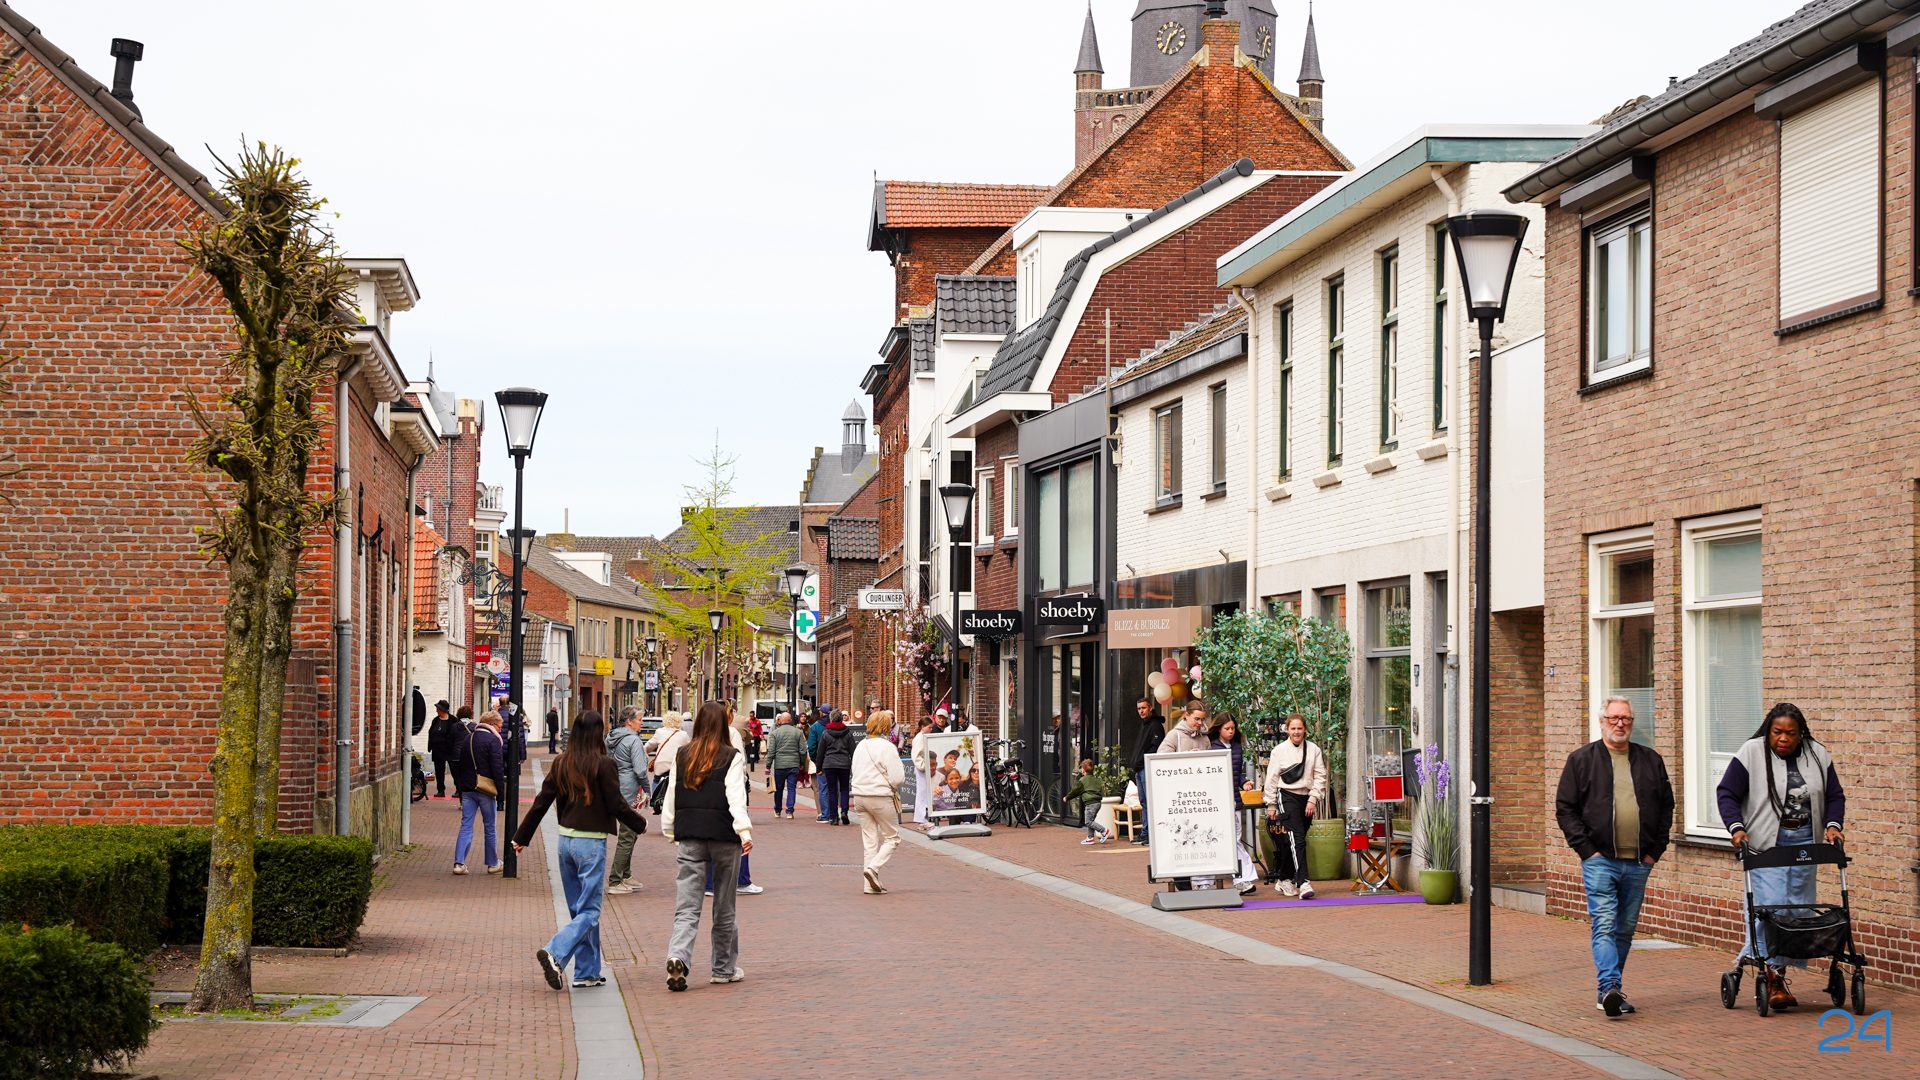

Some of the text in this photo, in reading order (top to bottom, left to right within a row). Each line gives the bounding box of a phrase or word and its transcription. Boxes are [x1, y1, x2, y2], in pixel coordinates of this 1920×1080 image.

[1040, 601, 1097, 622] shoeby
[965, 613, 1016, 631] shoeby
[1141, 618, 1170, 631] BUBBLEZ
[1155, 767, 1194, 777] Crystal
[1206, 766, 1223, 774] Ink
[1176, 791, 1207, 799] Tattoo
[1172, 798, 1213, 807] Piercing
[1168, 806, 1219, 815] Edelstenen
